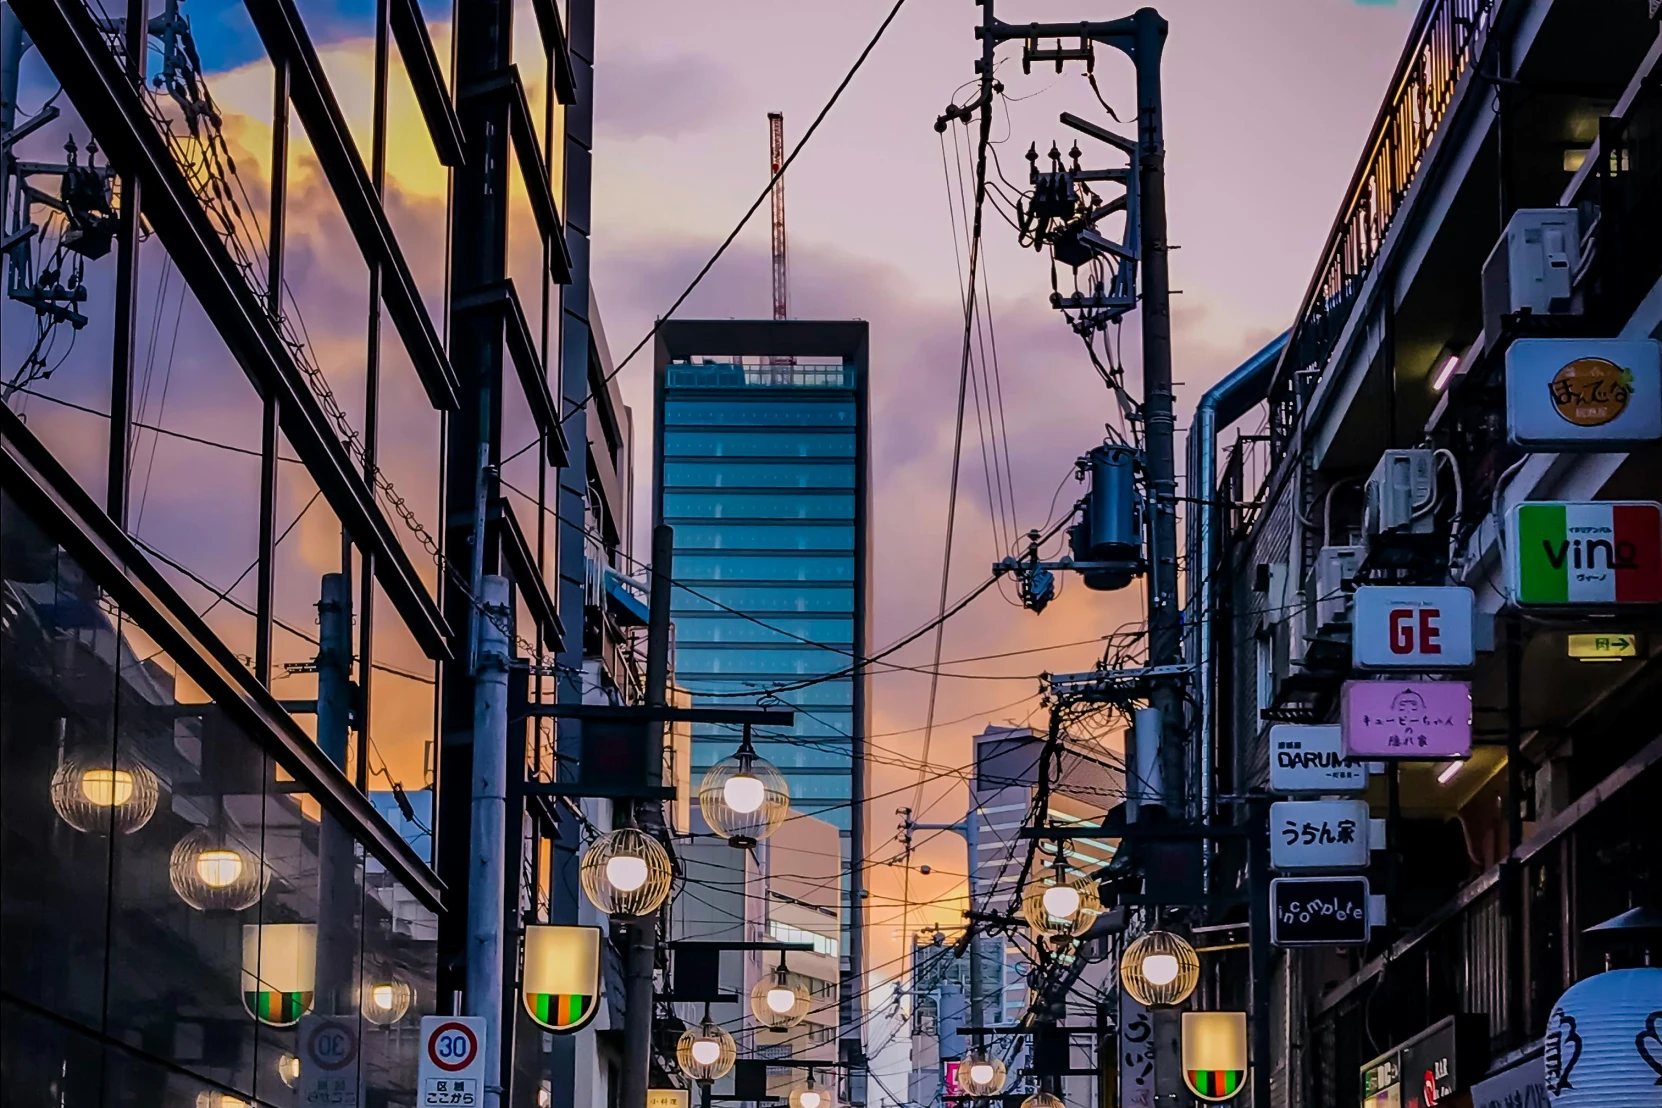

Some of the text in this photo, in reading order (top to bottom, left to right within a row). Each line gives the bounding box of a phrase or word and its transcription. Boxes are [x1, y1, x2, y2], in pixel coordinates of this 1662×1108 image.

[1543, 539, 1640, 570] vino
[1389, 608, 1442, 655] GE
[1278, 897, 1362, 924] incomplete
[439, 1035, 467, 1058] 30
[427, 1092, 474, 1105] ここから
